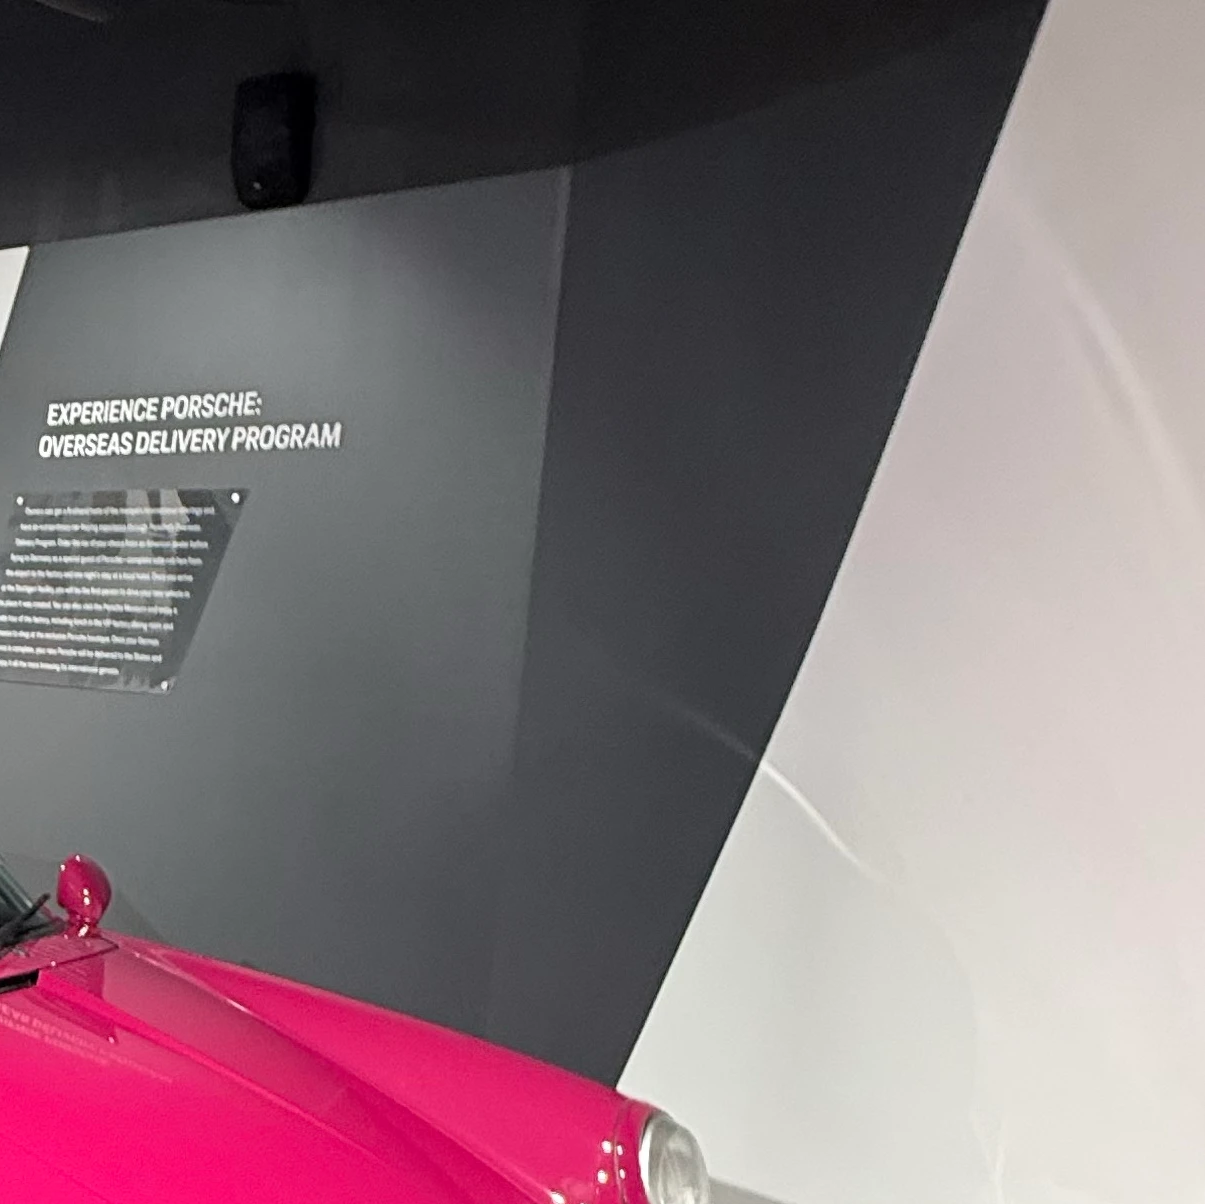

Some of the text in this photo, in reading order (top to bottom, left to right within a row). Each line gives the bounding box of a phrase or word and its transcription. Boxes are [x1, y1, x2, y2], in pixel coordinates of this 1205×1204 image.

[46, 390, 263, 427] EXPERIENCE PORSCHE:
[38, 421, 342, 458] OVERSEAS DELIVERY PROGRAM
